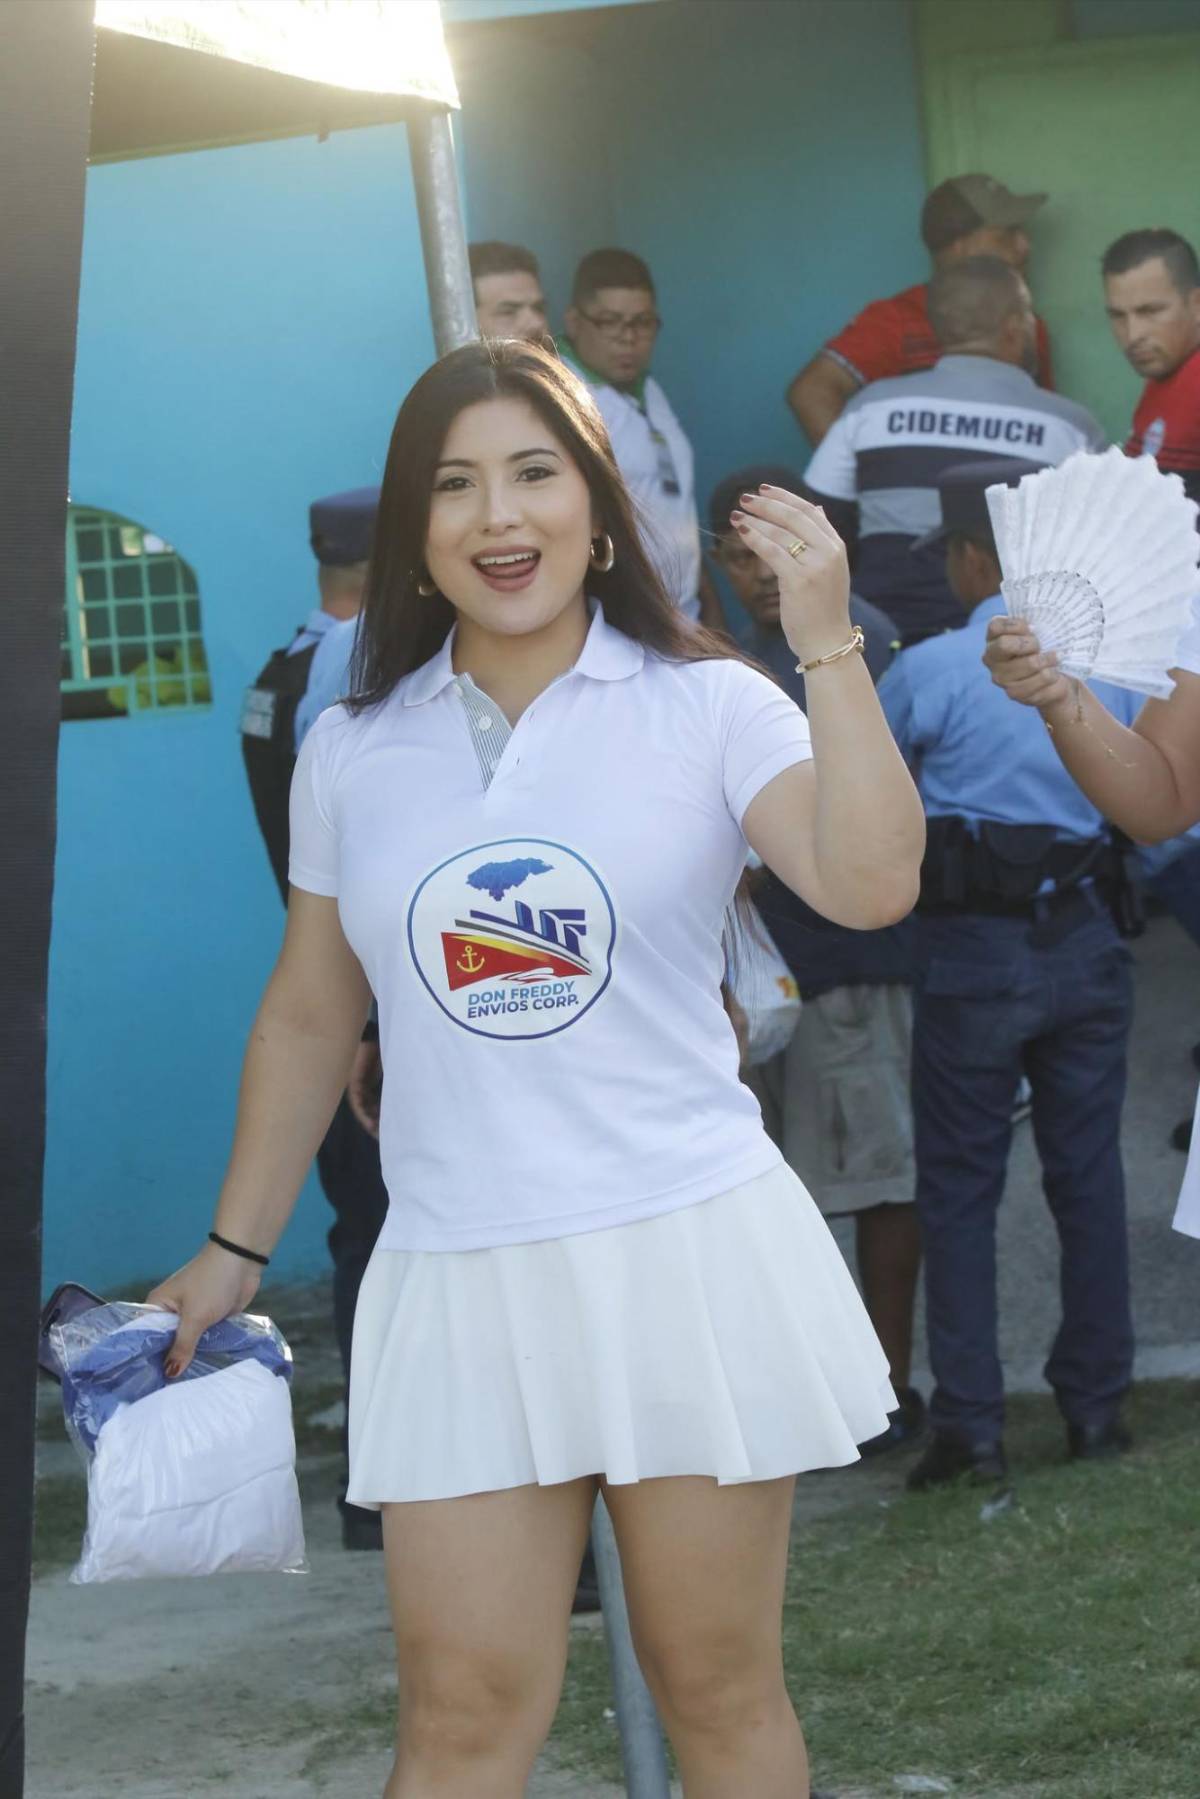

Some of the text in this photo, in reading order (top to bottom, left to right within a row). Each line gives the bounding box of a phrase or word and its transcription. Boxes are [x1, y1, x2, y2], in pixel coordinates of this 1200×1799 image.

[888, 410, 1045, 446] CIDEMUCH
[468, 981, 575, 1006] DON FREDDY
[468, 994, 579, 1018] ENVIOS CORP.
